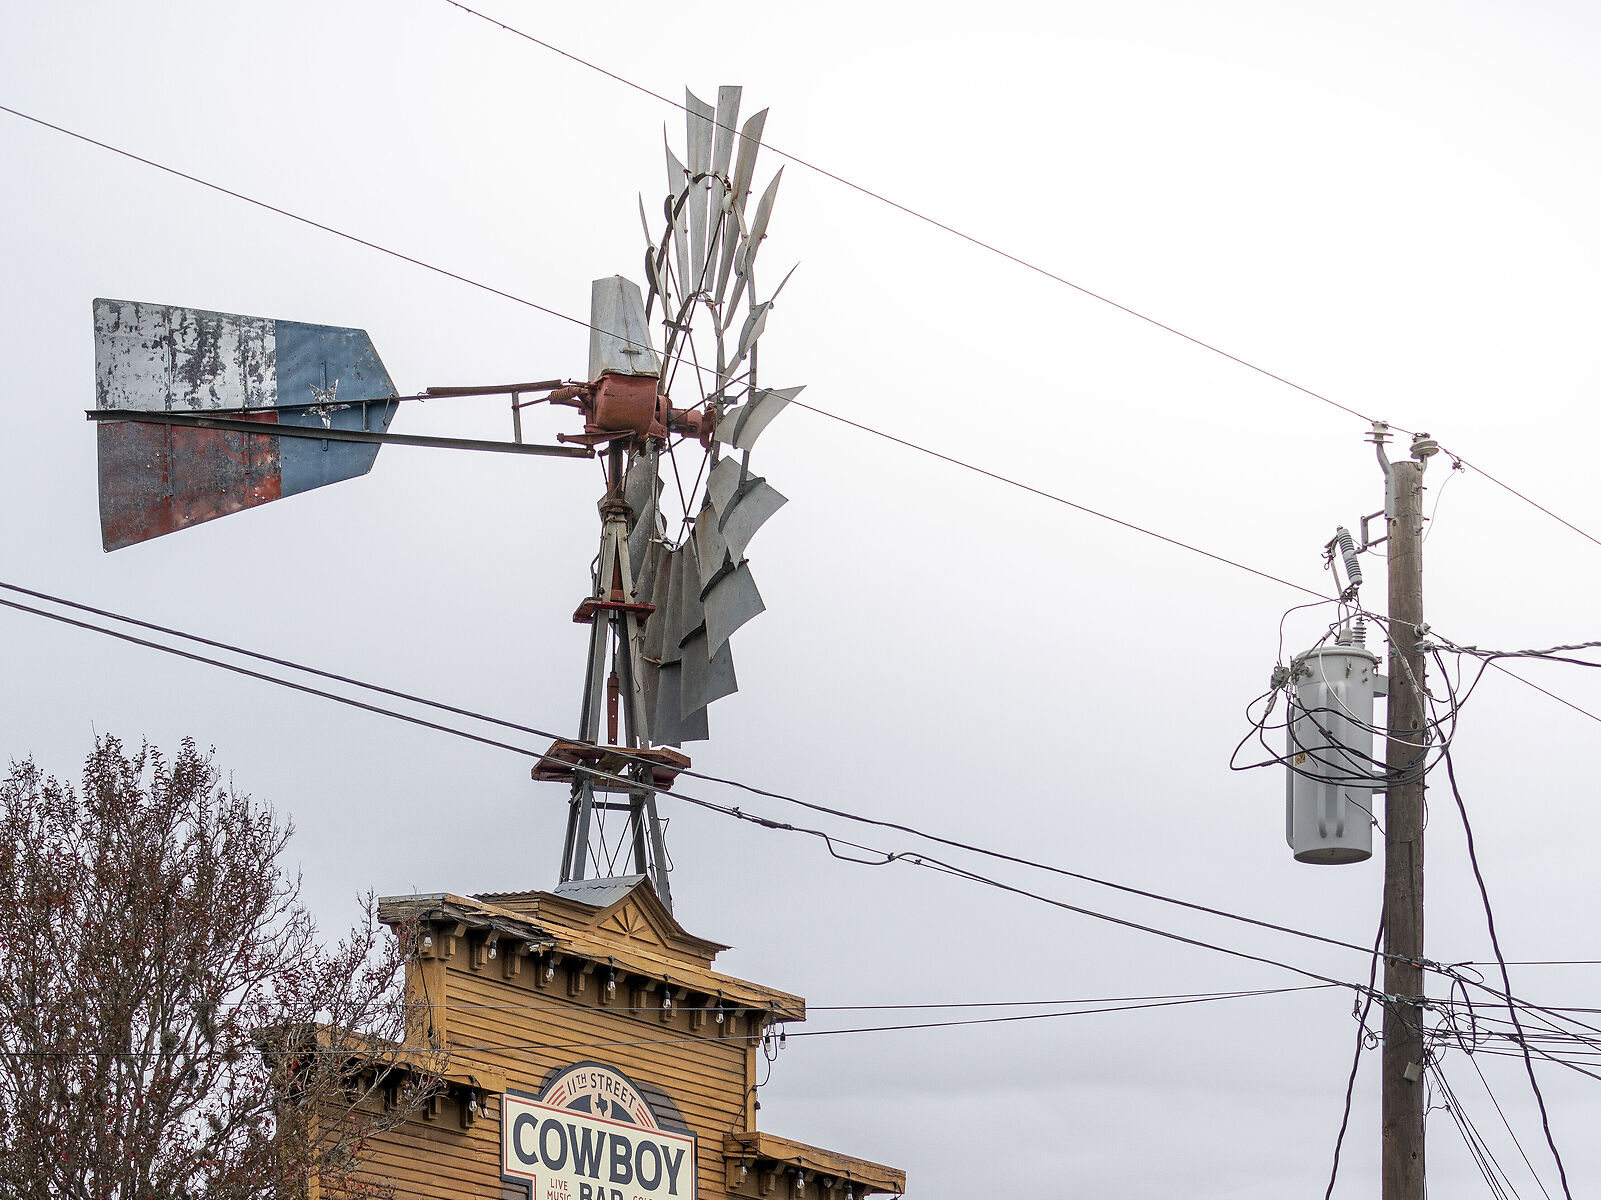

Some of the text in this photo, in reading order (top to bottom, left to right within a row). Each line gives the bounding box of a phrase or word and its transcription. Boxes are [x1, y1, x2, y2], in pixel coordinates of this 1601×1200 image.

[566, 1072, 636, 1109] 11TH STREET
[512, 1112, 686, 1196] COWBOY
[550, 1178, 568, 1191] LIVE
